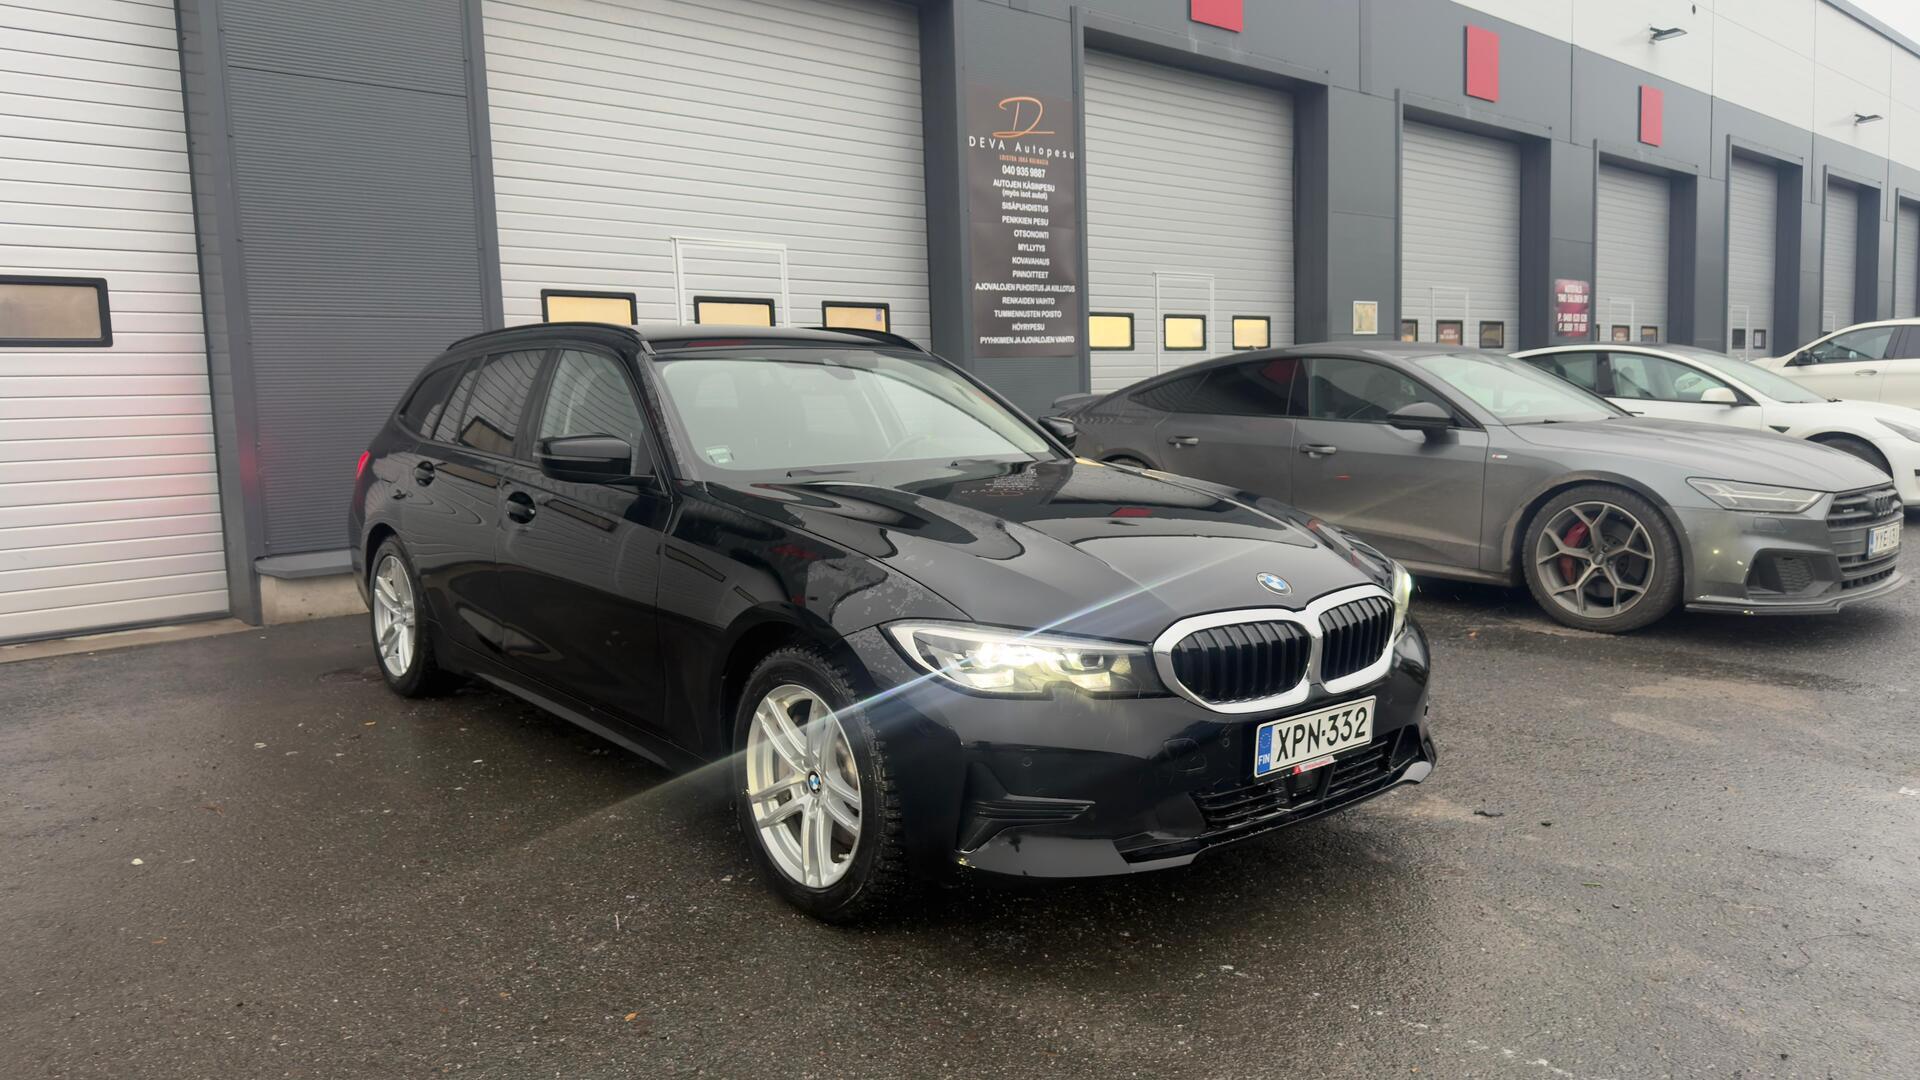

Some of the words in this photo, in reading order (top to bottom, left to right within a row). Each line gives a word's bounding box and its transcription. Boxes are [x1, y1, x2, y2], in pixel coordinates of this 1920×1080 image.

[968, 135, 1006, 151] DEVA
[1015, 141, 1075, 159] Autopesu
[1002, 164, 1015, 176] 040
[1016, 166, 1029, 177] 935
[1030, 167, 1046, 179] 9887
[993, 178, 1022, 189] AUTOJEN
[1002, 202, 1048, 213] SISÄPUHDISTUS
[1002, 215, 1032, 225] PENKKIEN
[1032, 217, 1049, 226] PESU
[1013, 229, 1049, 239] OTSONOINTI
[1017, 243, 1046, 253] MYLLYTYS
[1012, 257, 1050, 266] KOVAVAHAUS
[1012, 270, 1049, 279] PINNOITTEET
[974, 282, 1015, 292] AJOVALOJEN
[1015, 283, 1044, 293] PUHDISTUS
[1002, 296, 1035, 305] RENKAIDEN
[1035, 297, 1055, 306] VAIHTO
[1041, 310, 1062, 319] POISTO
[1011, 322, 1045, 332] HÖYRYPESU
[1021, 336, 1056, 345] AJOVALOJEN
[1055, 335, 1075, 344] VAIHTO
[1276, 706, 1367, 762] XPN-332
[1258, 753, 1271, 765] FIN
